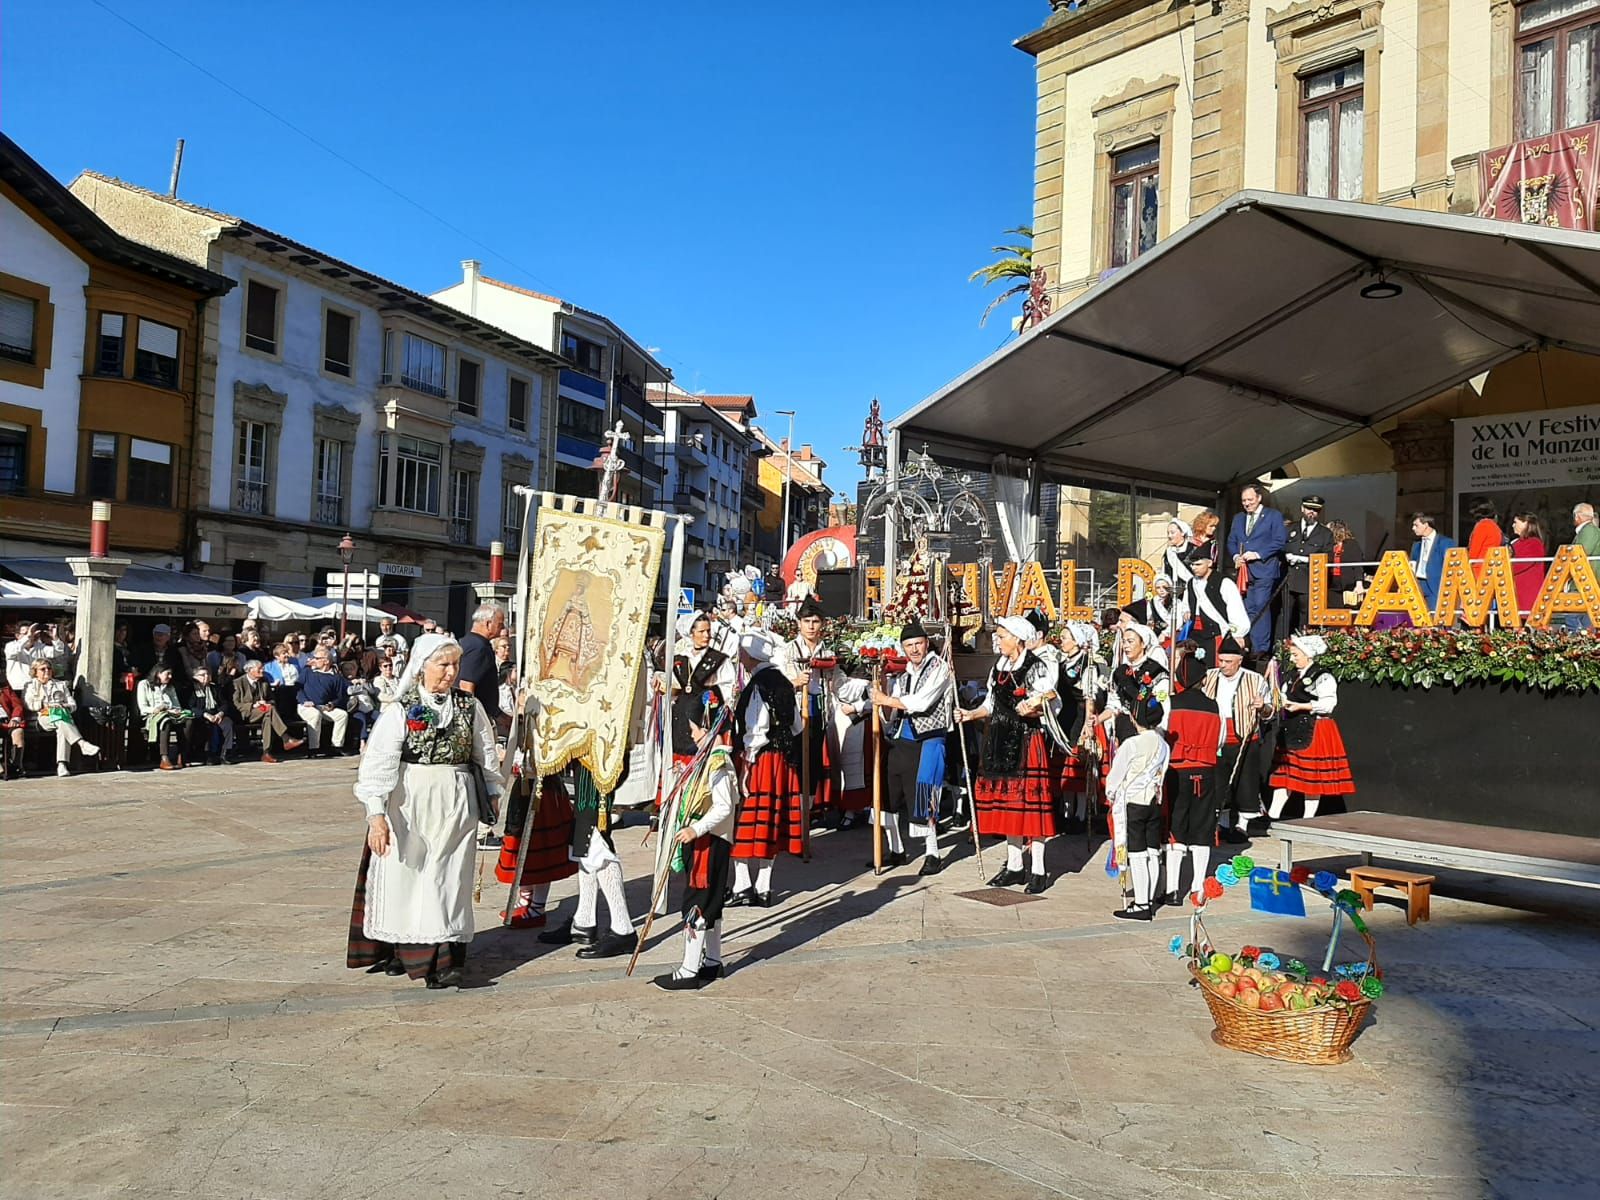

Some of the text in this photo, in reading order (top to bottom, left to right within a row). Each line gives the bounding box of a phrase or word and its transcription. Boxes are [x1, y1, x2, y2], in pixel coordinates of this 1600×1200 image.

[1471, 421, 1531, 442] XXXV
[1472, 444, 1495, 460] de
[1503, 442, 1520, 458] la
[386, 565, 415, 576] NOTARIA
